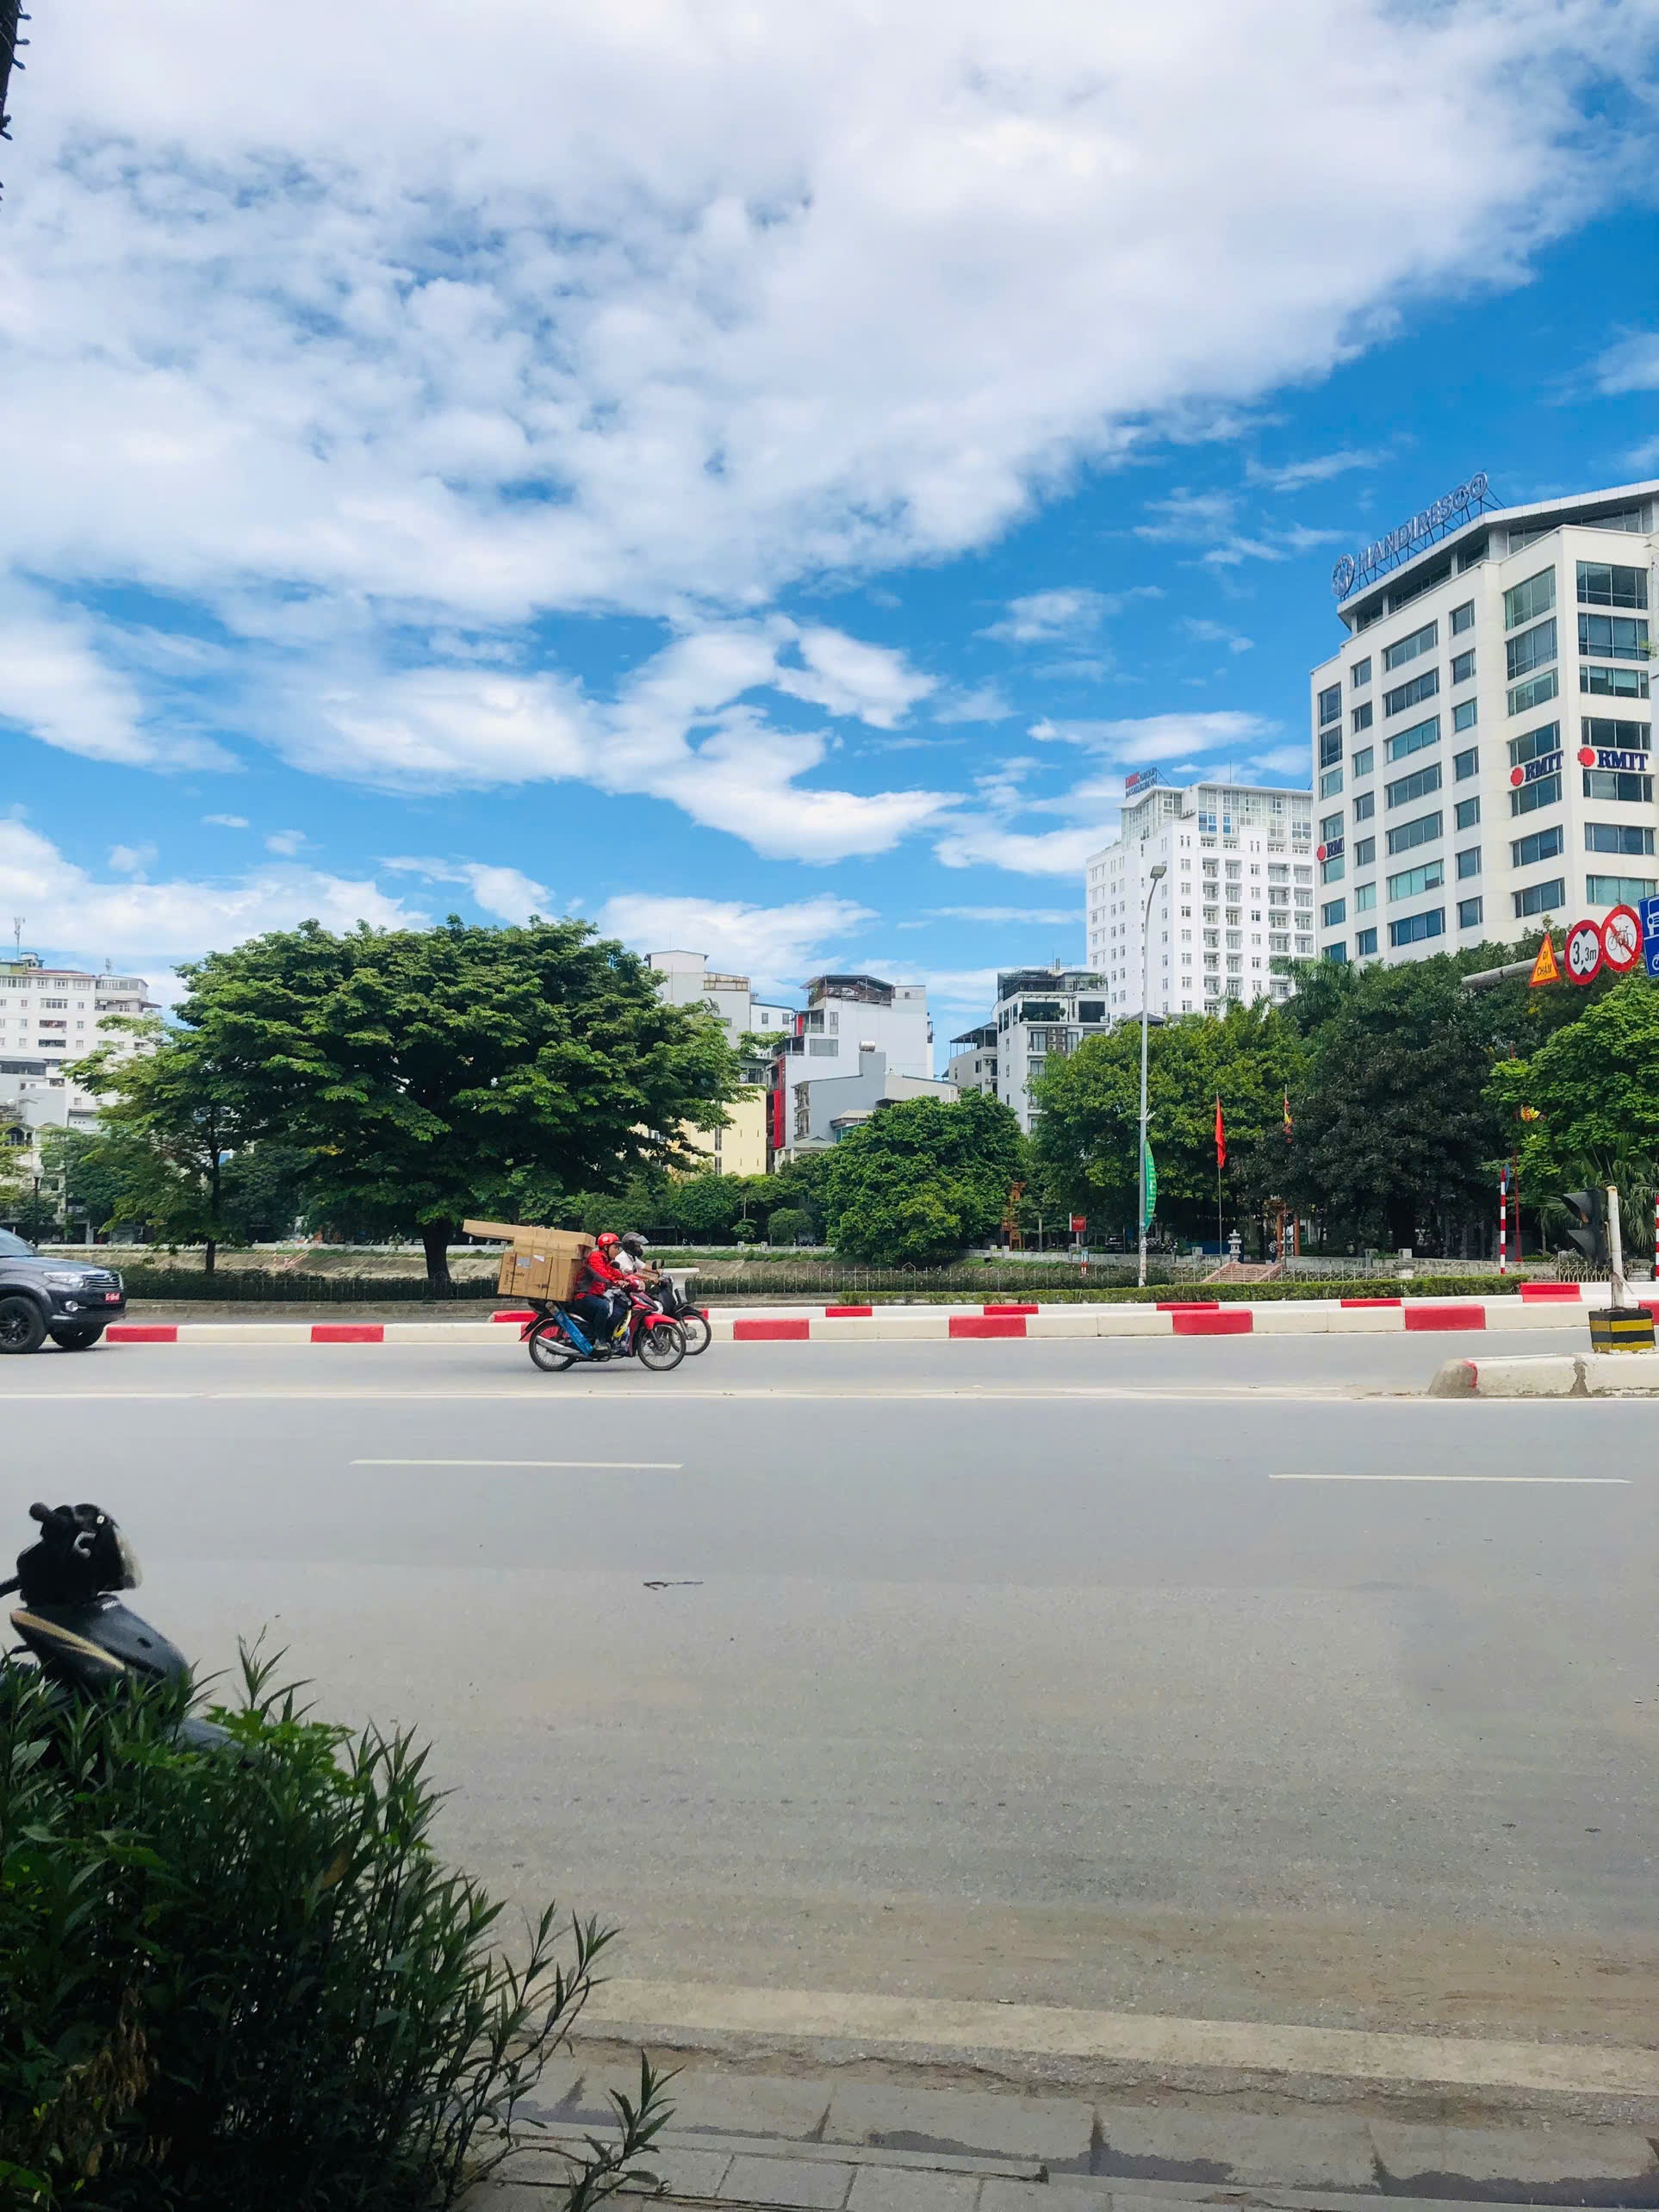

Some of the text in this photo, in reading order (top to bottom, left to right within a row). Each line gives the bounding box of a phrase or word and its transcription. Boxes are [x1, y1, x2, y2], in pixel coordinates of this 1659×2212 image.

[1358, 471, 1488, 572] HANDIRESCO
[1525, 749, 1564, 782] RMIT
[1597, 749, 1649, 772] RMIT
[1573, 941, 1596, 965] 3,3m
